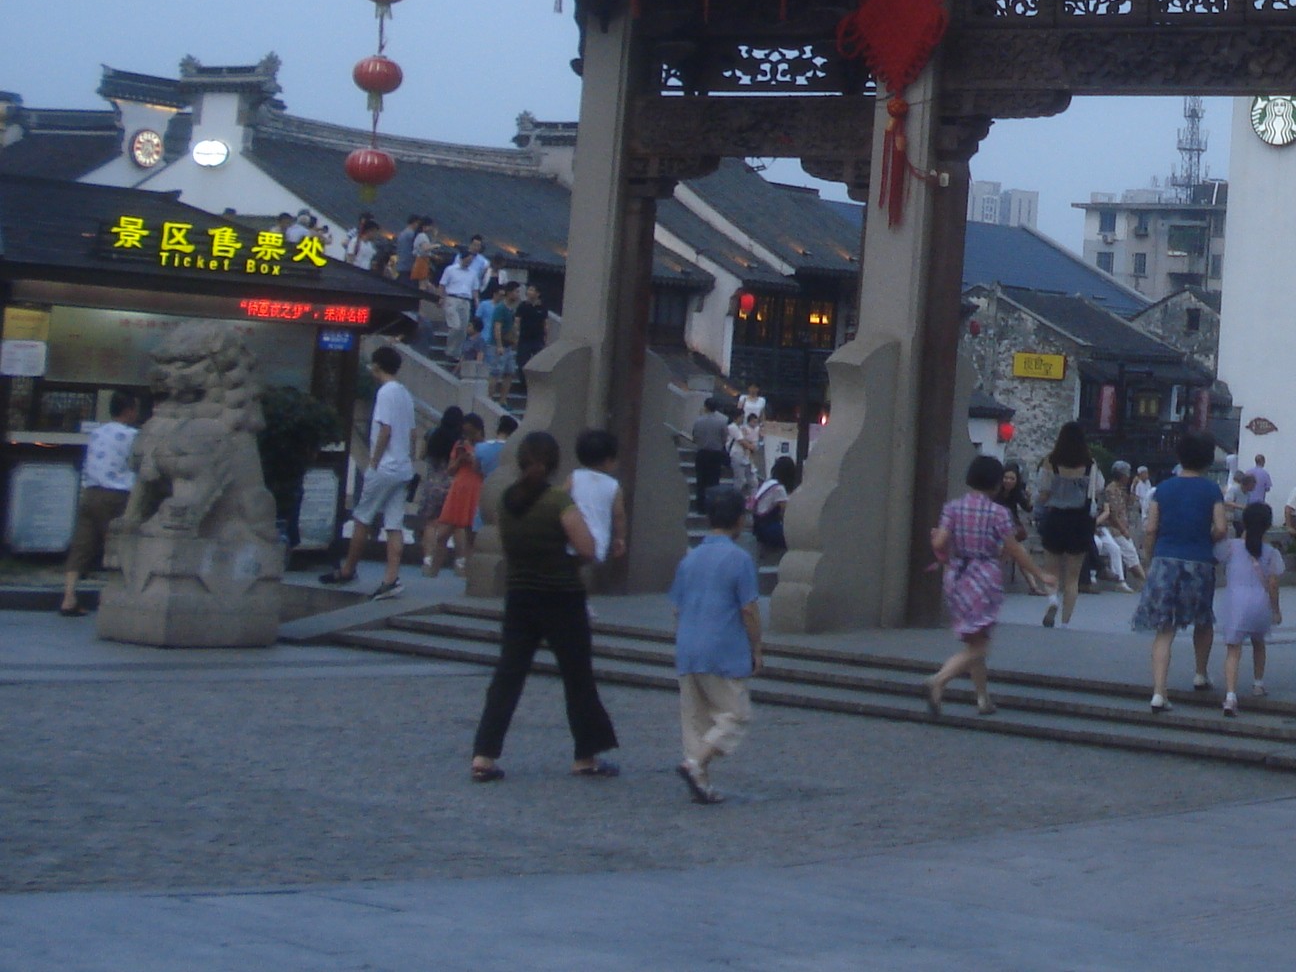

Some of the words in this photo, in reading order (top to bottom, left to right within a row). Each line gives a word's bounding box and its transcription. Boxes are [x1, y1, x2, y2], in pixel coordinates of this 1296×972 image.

[111, 216, 328, 267] 景区售票处
[159, 252, 230, 271] Ticket
[246, 259, 281, 276] Box
